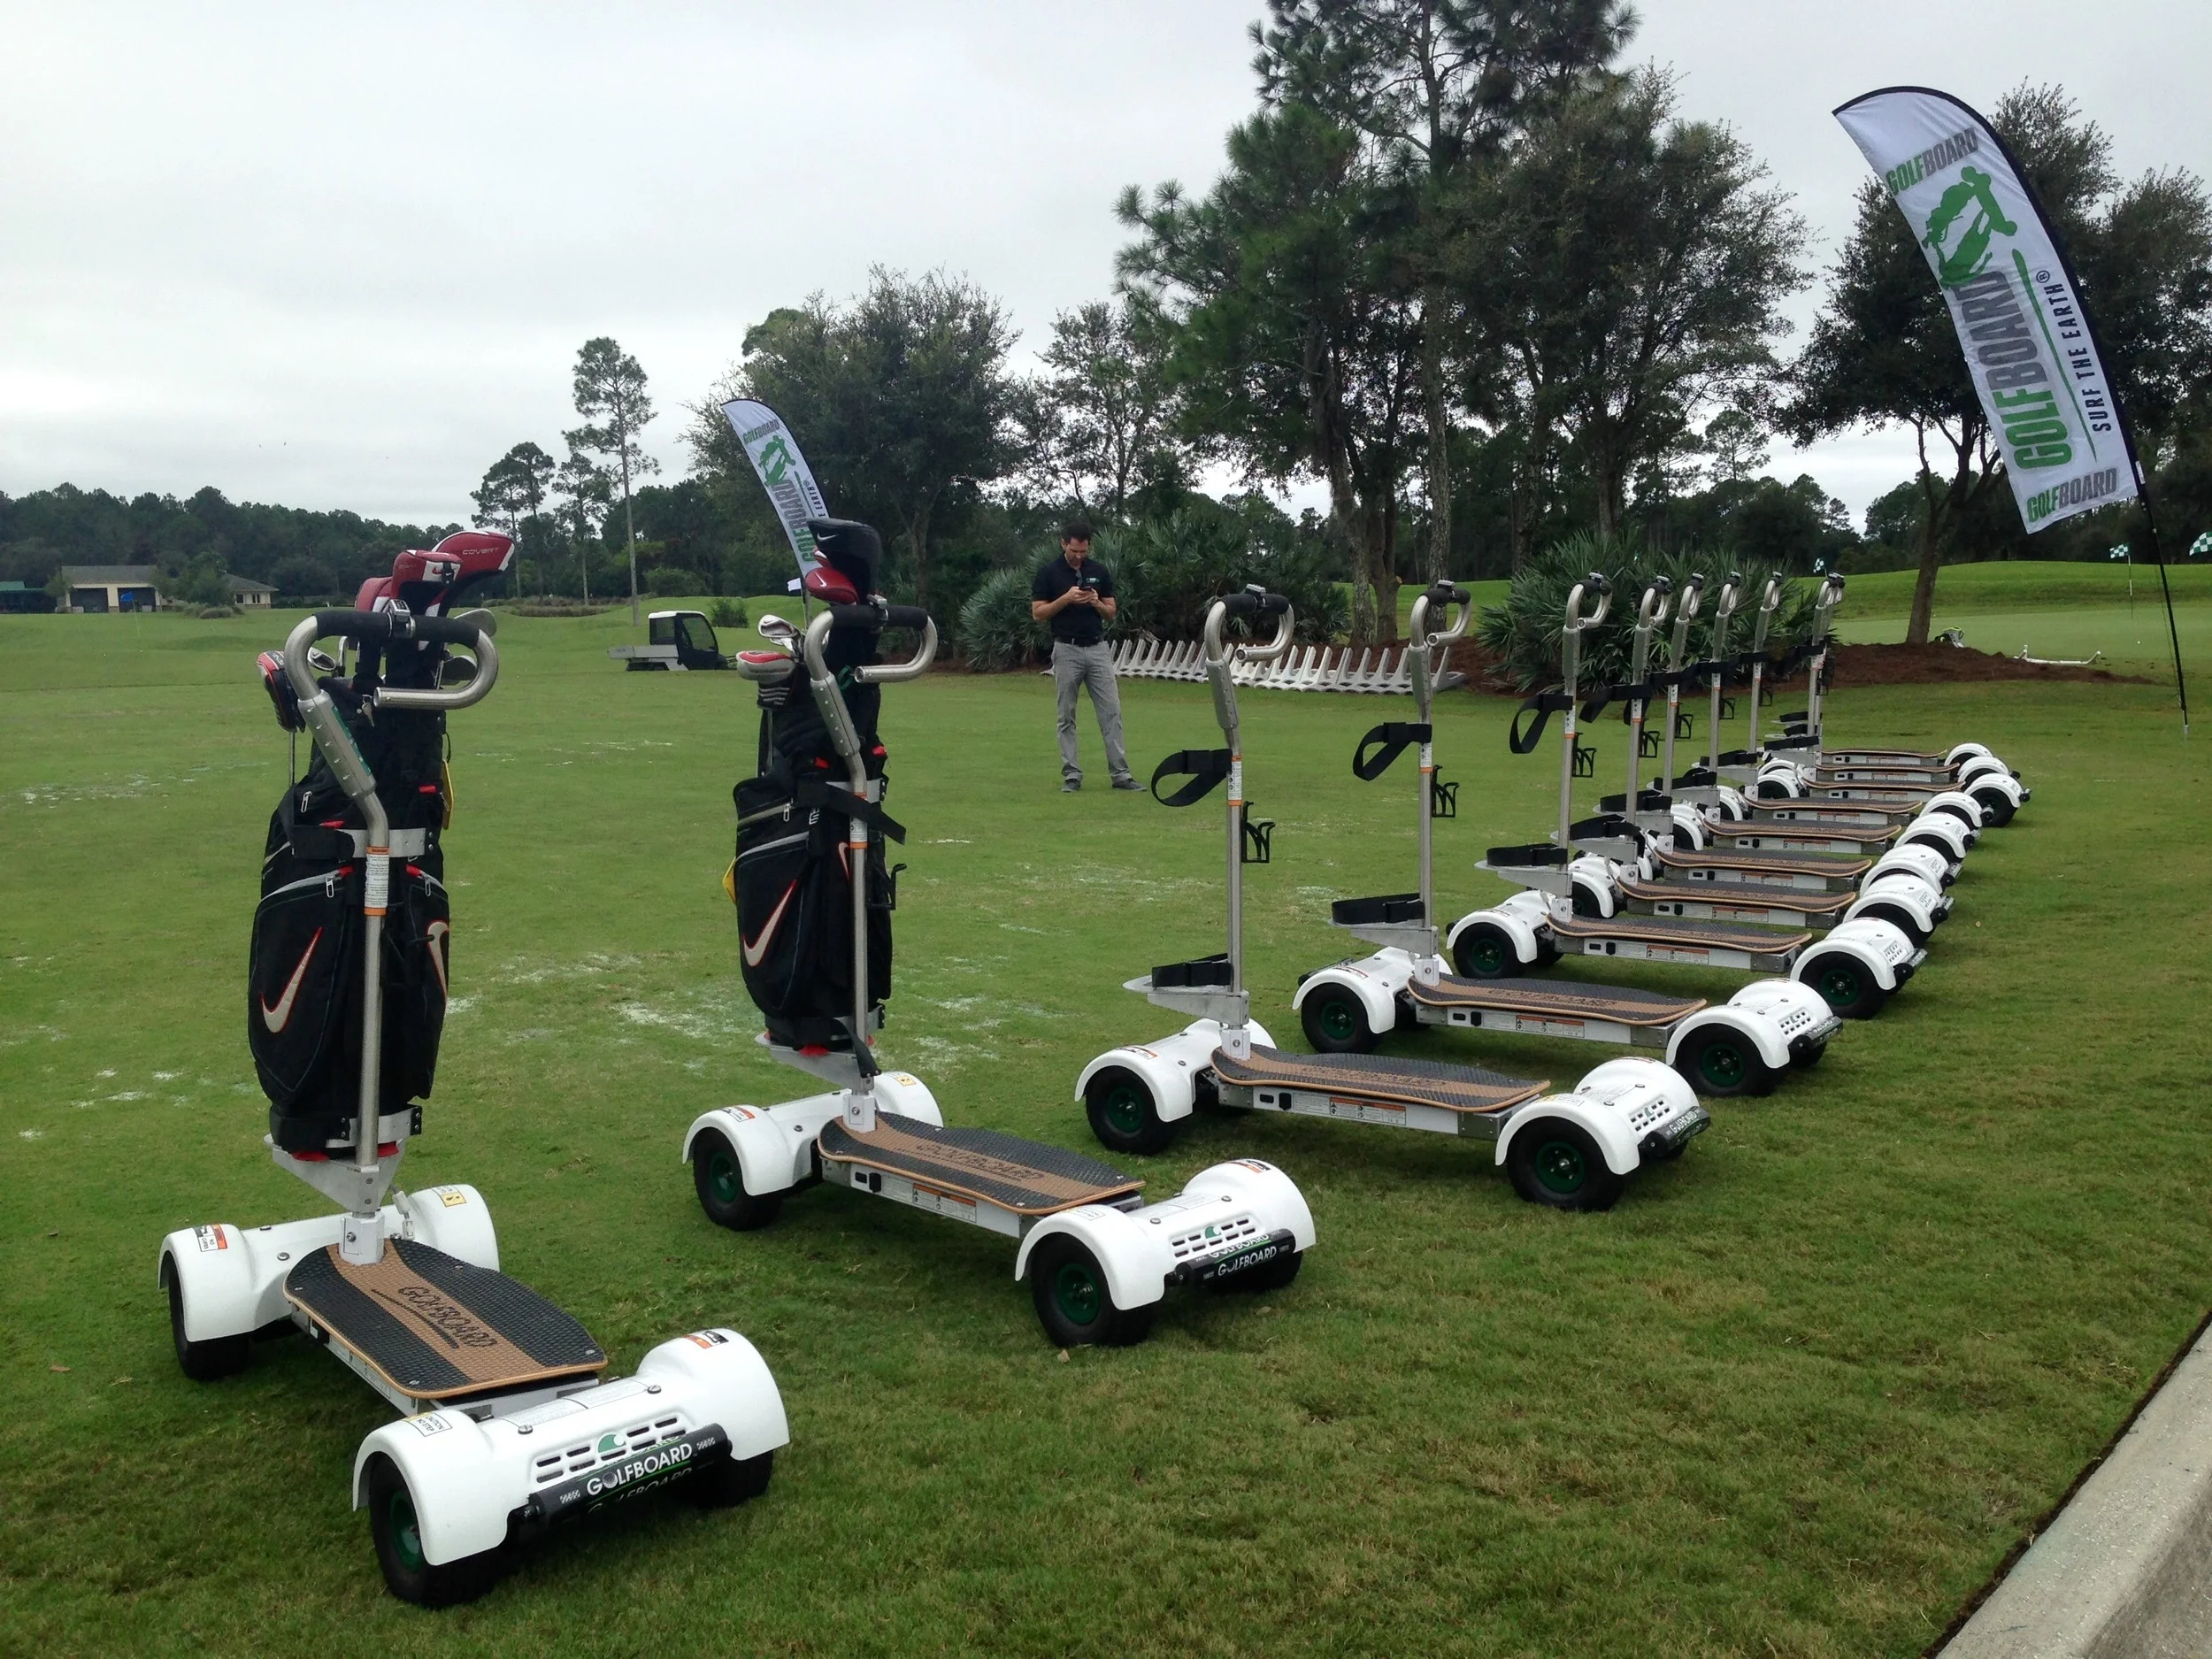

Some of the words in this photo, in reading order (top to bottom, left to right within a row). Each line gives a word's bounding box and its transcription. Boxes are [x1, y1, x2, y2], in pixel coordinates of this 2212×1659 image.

[1886, 127, 1978, 196] GOLFBOARD
[1950, 271, 2072, 470] GOLFBOARD
[2068, 347, 2095, 380] THE
[2081, 388, 2111, 432] SURF
[2026, 467, 2117, 523] GOLFBOARD
[587, 1443, 692, 1496] GOLFBOARD
